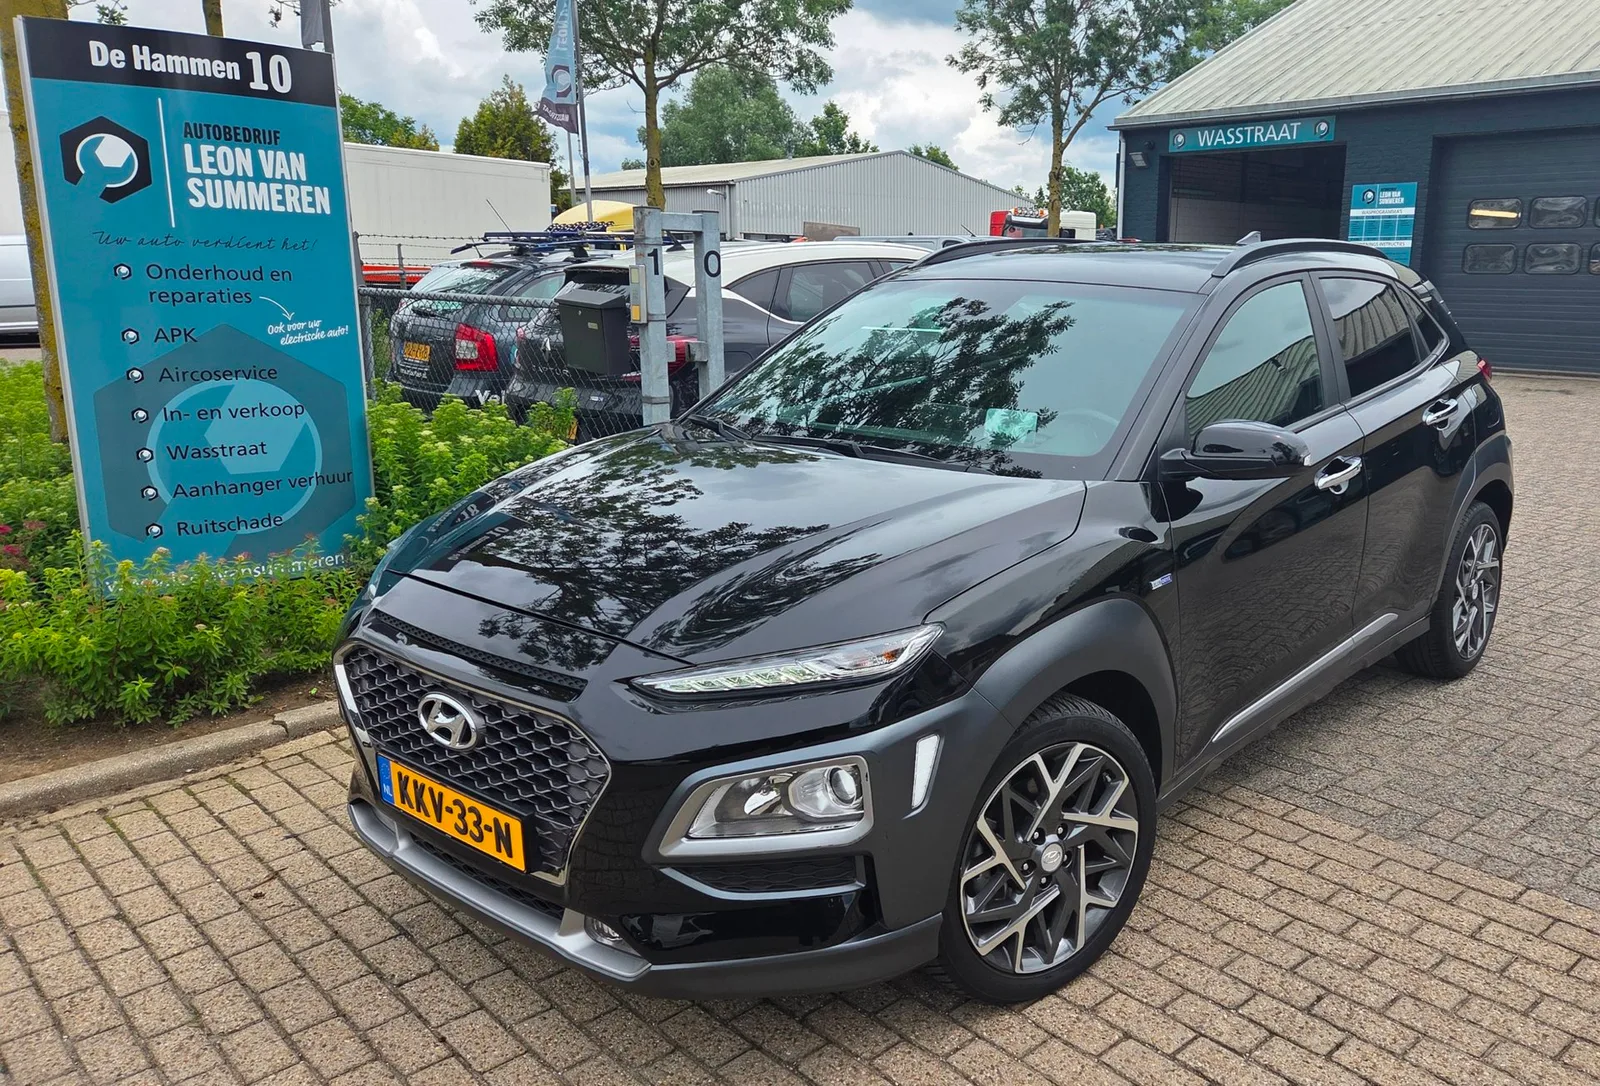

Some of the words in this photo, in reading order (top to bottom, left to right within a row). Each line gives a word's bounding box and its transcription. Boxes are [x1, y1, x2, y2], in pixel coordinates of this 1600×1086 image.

[88, 40, 126, 67] De
[132, 44, 241, 81] Hammen
[246, 51, 293, 94] 10
[183, 121, 281, 146] AUTOBEDRIJF
[1197, 122, 1301, 147] WASSTRAAT
[183, 143, 254, 178] LEON
[257, 149, 307, 181] VAN
[187, 178, 331, 215] SUMMEREN
[93, 231, 131, 245] Uw
[137, 233, 185, 247] auto
[192, 236, 276, 250] verdient
[281, 237, 319, 251] het!
[146, 263, 264, 282] Onderhoud
[270, 267, 293, 282] en
[647, 248, 660, 276] 1
[703, 250, 721, 278] 0
[149, 288, 253, 307] reparaties
[154, 327, 198, 343] APK
[267, 322, 285, 335] Ook
[287, 322, 306, 332] voor
[308, 320, 322, 328] uw
[280, 328, 326, 346] electrische
[327, 325, 349, 337] auto!
[159, 365, 278, 383] Aircoservice
[163, 407, 190, 422] In-
[197, 408, 221, 421] en
[228, 402, 305, 419] verkoop
[166, 441, 268, 460] Wasstraat
[172, 478, 283, 499] Aanhanger
[288, 470, 353, 488] verhuur
[177, 513, 284, 537] Ruitschade
[383, 784, 393, 797] NL
[397, 771, 514, 858] KKV-33-N
